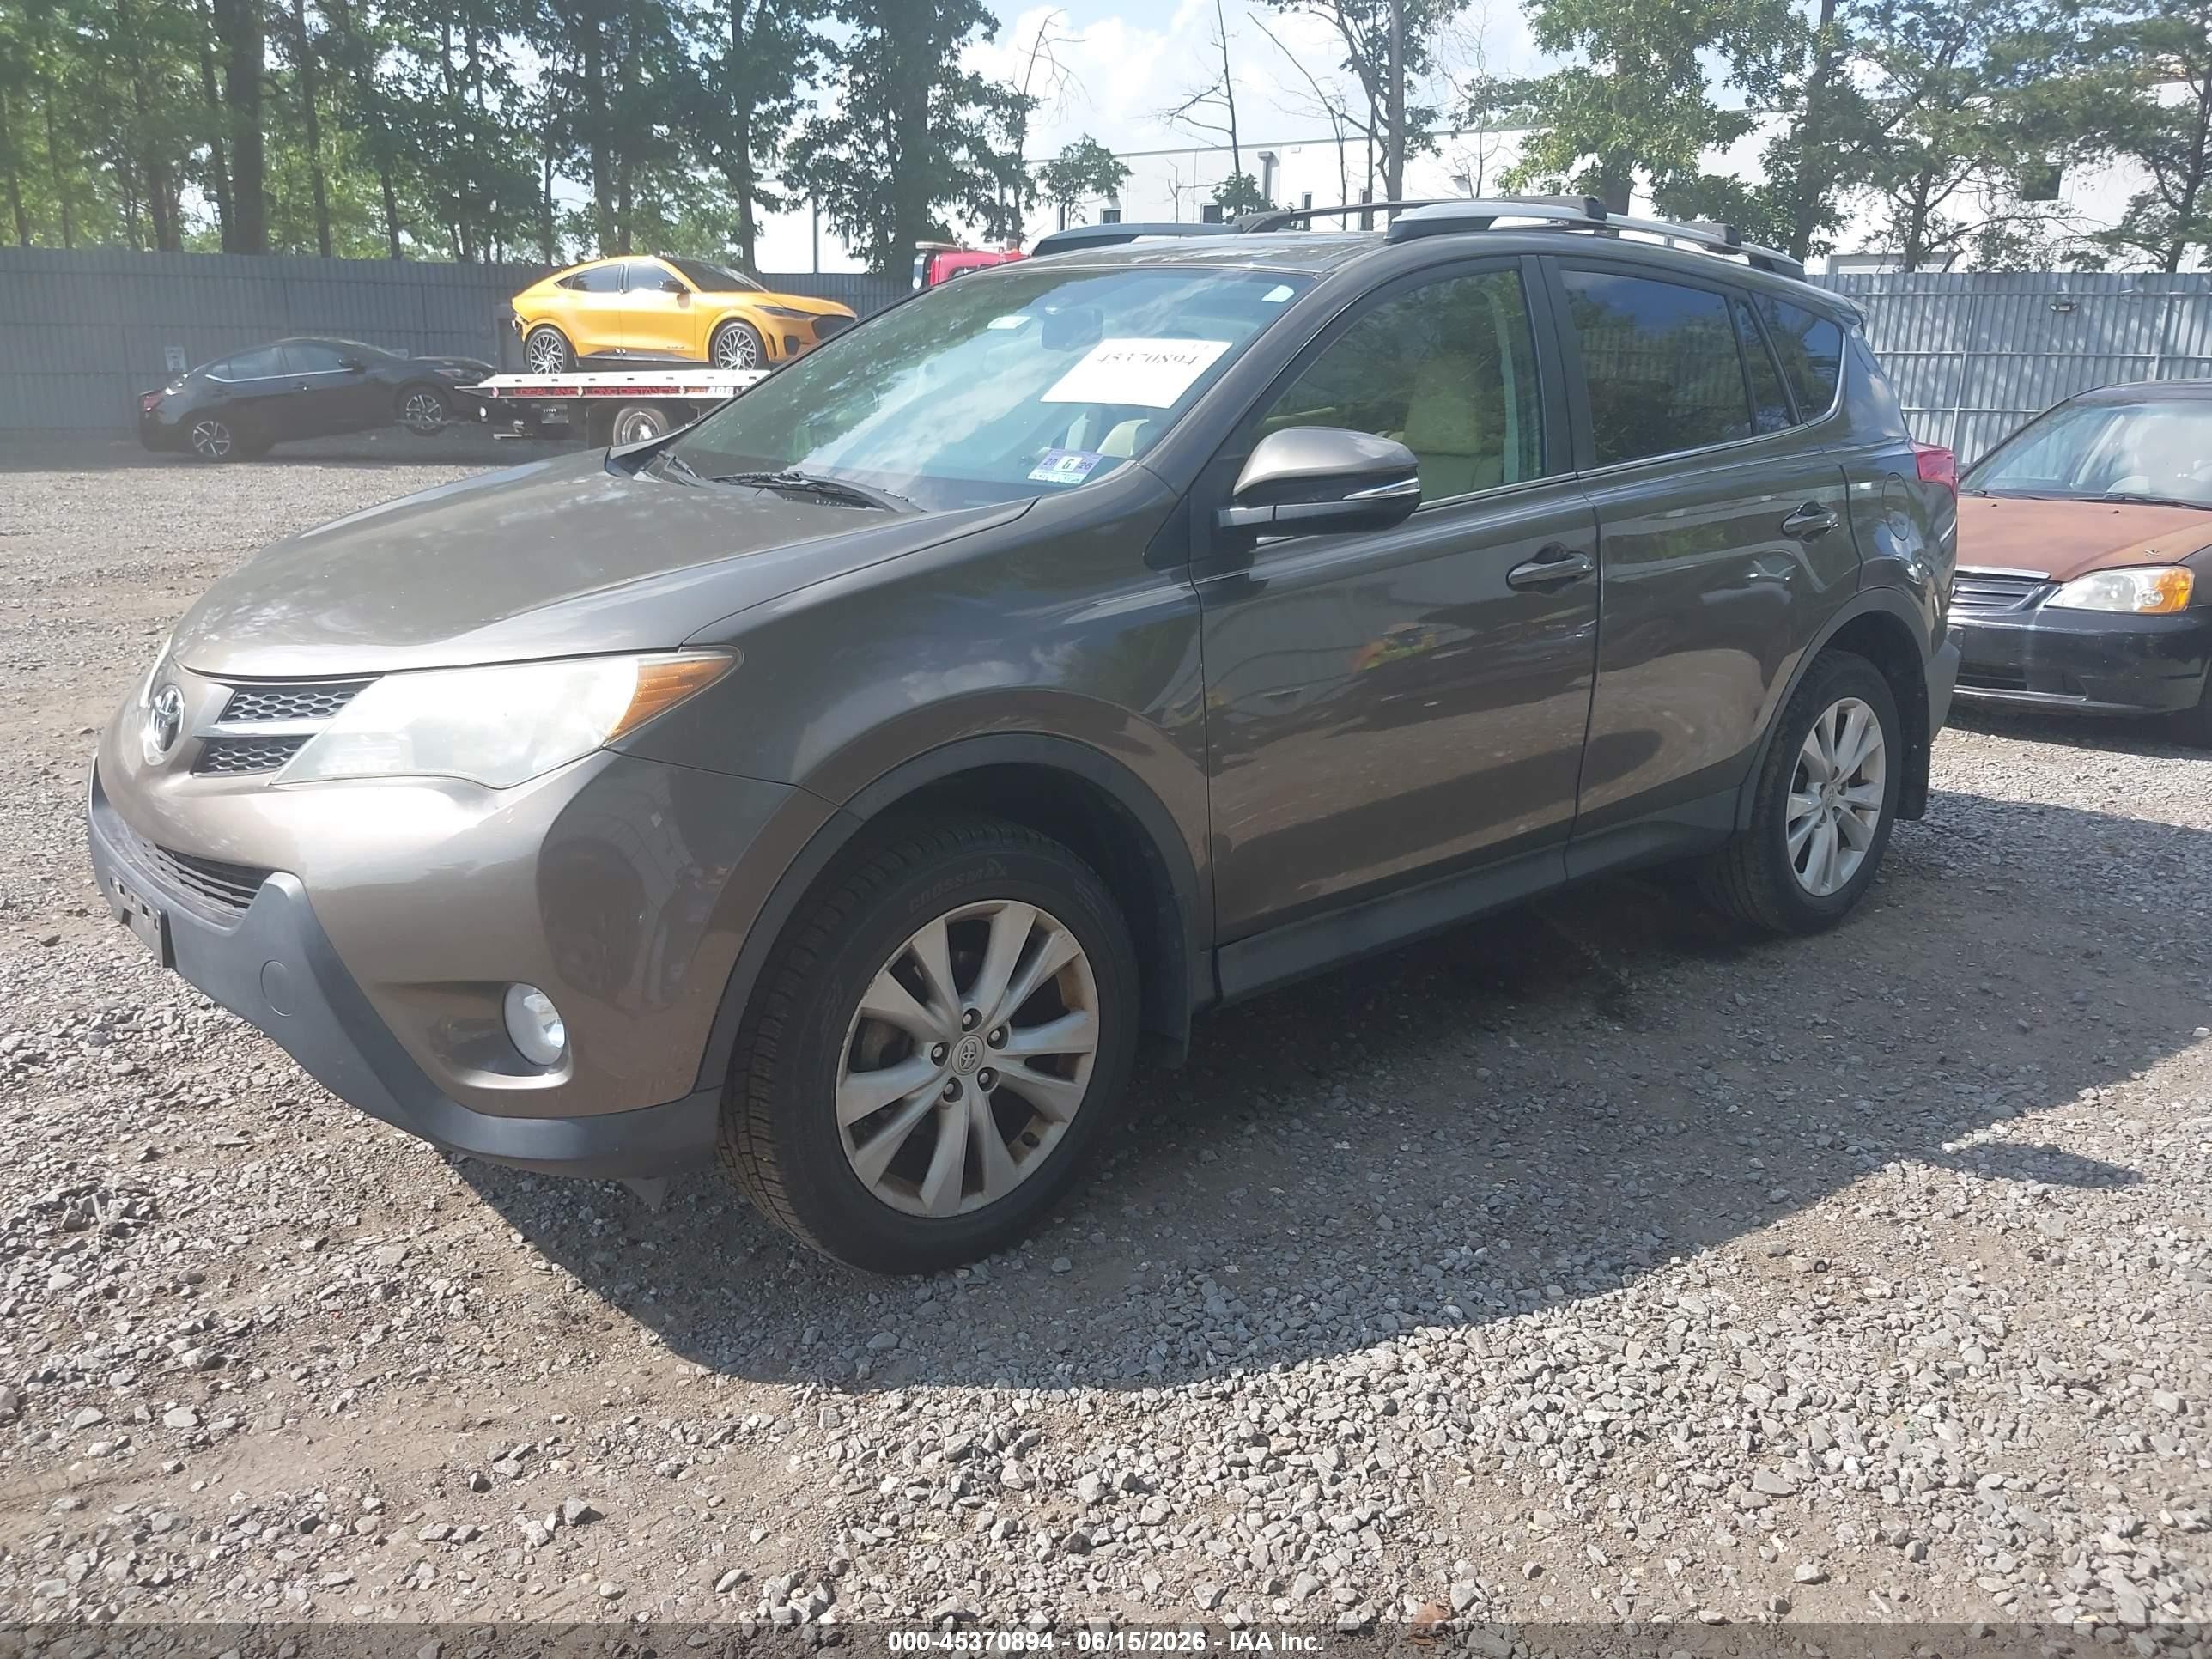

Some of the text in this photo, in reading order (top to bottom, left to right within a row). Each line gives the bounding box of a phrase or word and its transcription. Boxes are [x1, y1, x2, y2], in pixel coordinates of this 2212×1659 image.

[514, 387, 551, 397] LOCAL
[585, 387, 617, 397] LONG
[618, 386, 678, 397] DISTANCE
[1043, 458, 1059, 466] 20
[1062, 459, 1075, 470] 6
